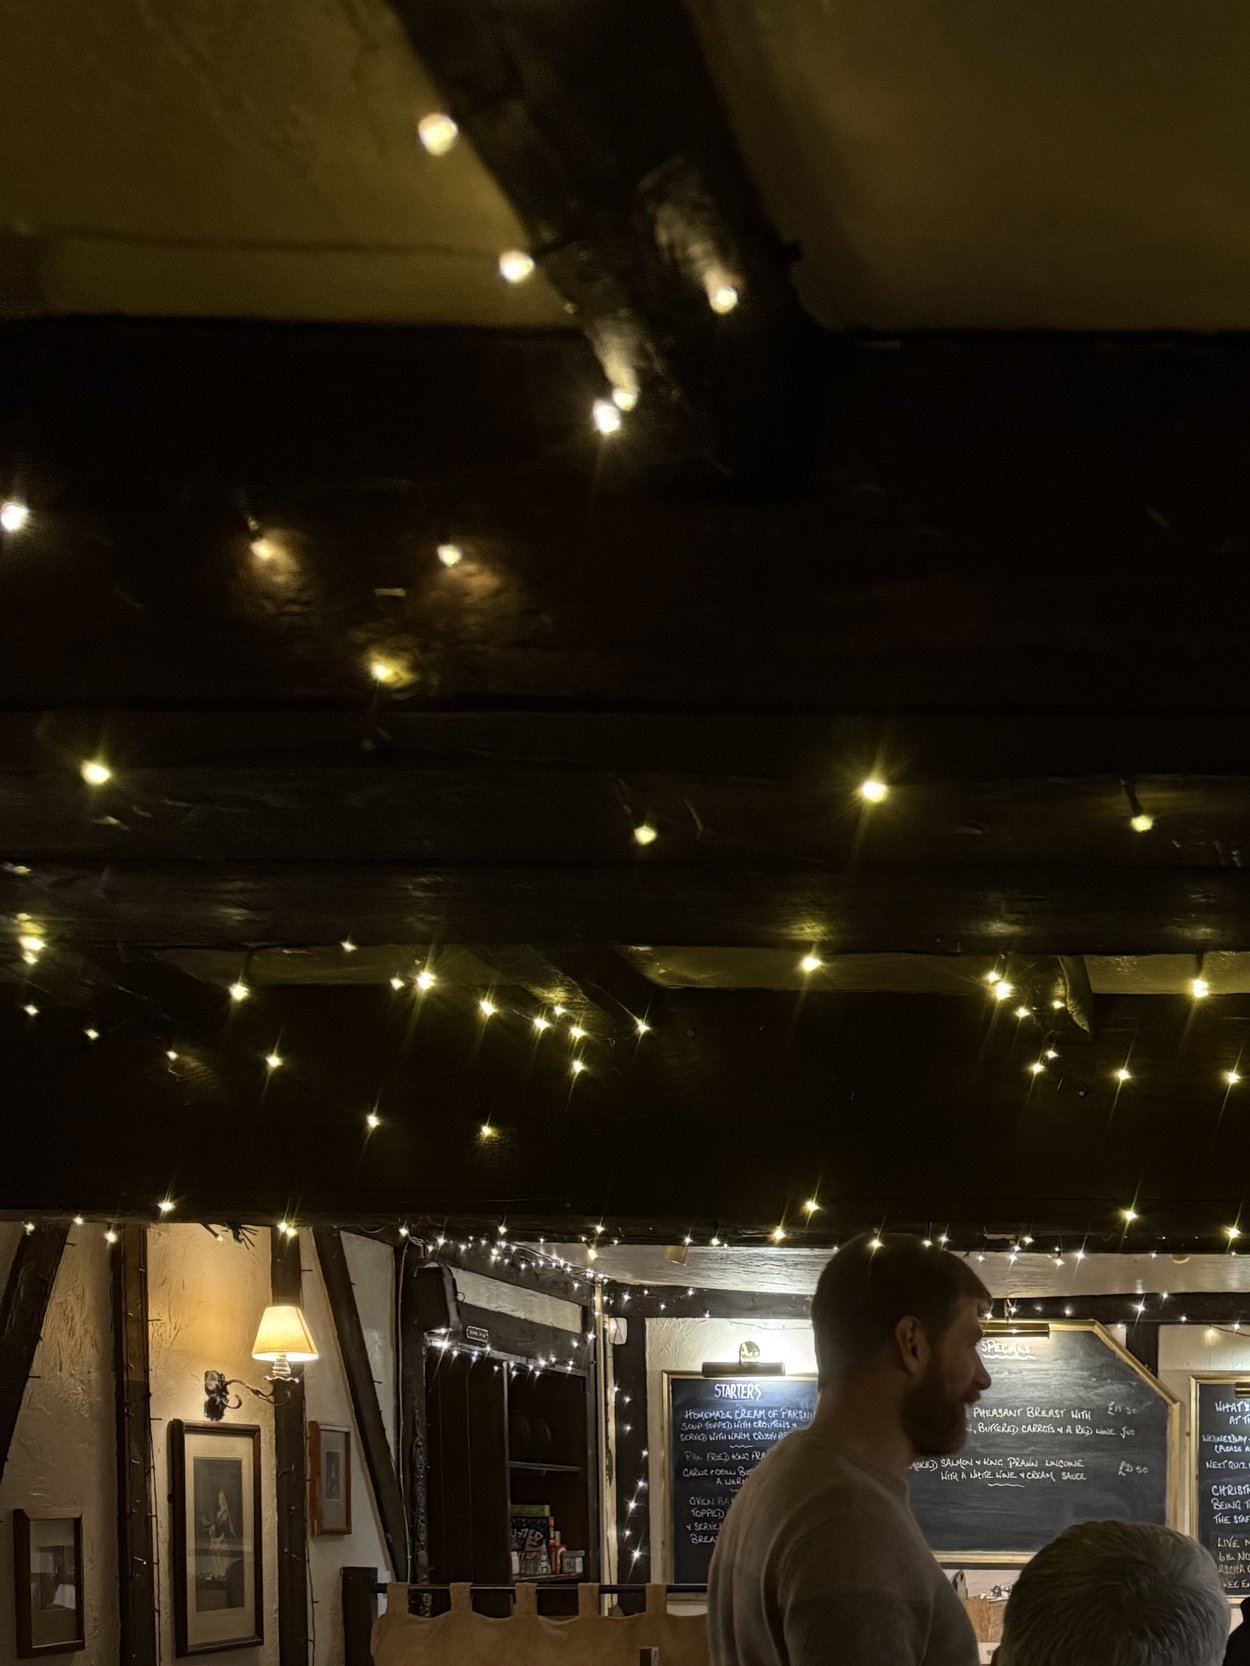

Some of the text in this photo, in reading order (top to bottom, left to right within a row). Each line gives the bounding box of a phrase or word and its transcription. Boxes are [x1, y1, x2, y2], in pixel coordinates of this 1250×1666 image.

[714, 1384, 762, 1400] STARTERS
[684, 1409, 732, 1420] HOMEMADE
[734, 1408, 766, 1420] CREAM
[768, 1408, 778, 1419] OF
[974, 1407, 1023, 1418] PHEASANT
[1026, 1407, 1067, 1418] BREAST
[1071, 1409, 1092, 1421] WITH
[1229, 1415, 1241, 1425] AT
[681, 1422, 702, 1431] SOUP
[705, 1422, 733, 1431] TOPPED
[733, 1421, 751, 1430] WITH
[753, 1421, 791, 1431] CROUTONS
[978, 1423, 1019, 1435] BUTTERED
[1021, 1424, 1056, 1434] CARROTS
[1065, 1425, 1073, 1434] A
[1076, 1425, 1093, 1436] RED
[1095, 1427, 1117, 1435] WINE
[680, 1432, 707, 1442] SERVED
[709, 1432, 727, 1441] WITH
[728, 1432, 751, 1441] WARM
[707, 1452, 731, 1462] FRIED
[731, 1452, 749, 1460] KING
[751, 1450, 767, 1460] PRA
[940, 1458, 974, 1468] SALMON
[983, 1458, 1003, 1467] KING
[1008, 1457, 1038, 1468] PRAWN
[1205, 1460, 1227, 1470] NEXT
[1228, 1460, 1248, 1470] QUIZ
[941, 1472, 960, 1481] WITH
[960, 1471, 967, 1480] A
[970, 1471, 994, 1479] WHITE
[995, 1471, 1018, 1480] WINE
[1026, 1471, 1057, 1482] CREAM
[1061, 1471, 1087, 1481] SAUCE
[689, 1497, 715, 1505] OVEN
[1210, 1498, 1242, 1510] BEING
[691, 1509, 725, 1519] TOPPED
[1213, 1513, 1231, 1524] THE
[694, 1522, 720, 1531] SERVE
[690, 1534, 717, 1544] BREA
[1217, 1536, 1240, 1548] LIVE
